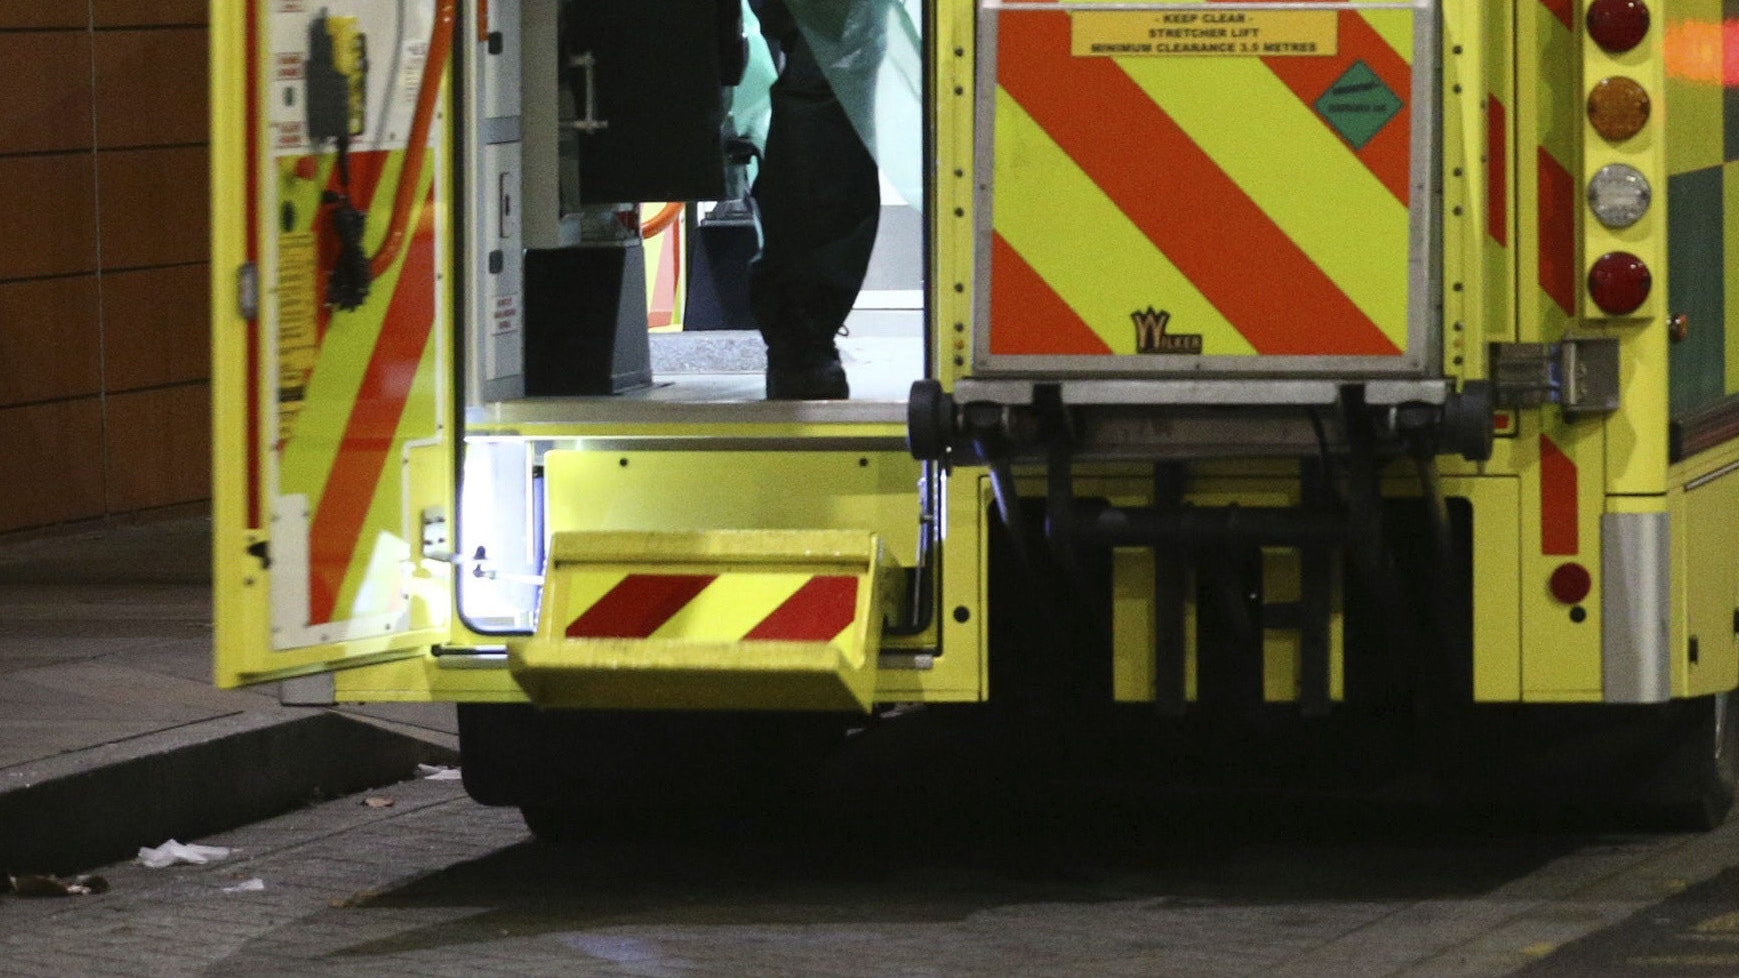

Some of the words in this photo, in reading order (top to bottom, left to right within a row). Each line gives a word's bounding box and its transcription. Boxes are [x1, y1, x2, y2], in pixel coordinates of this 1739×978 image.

[1163, 14, 1198, 23] KEEP
[1202, 13, 1246, 23] CLEAR
[1149, 28, 1227, 38] STRETCHER
[1231, 27, 1260, 37] LIFT
[1156, 43, 1235, 53] CLEARANCE
[1263, 42, 1316, 52] METRES
